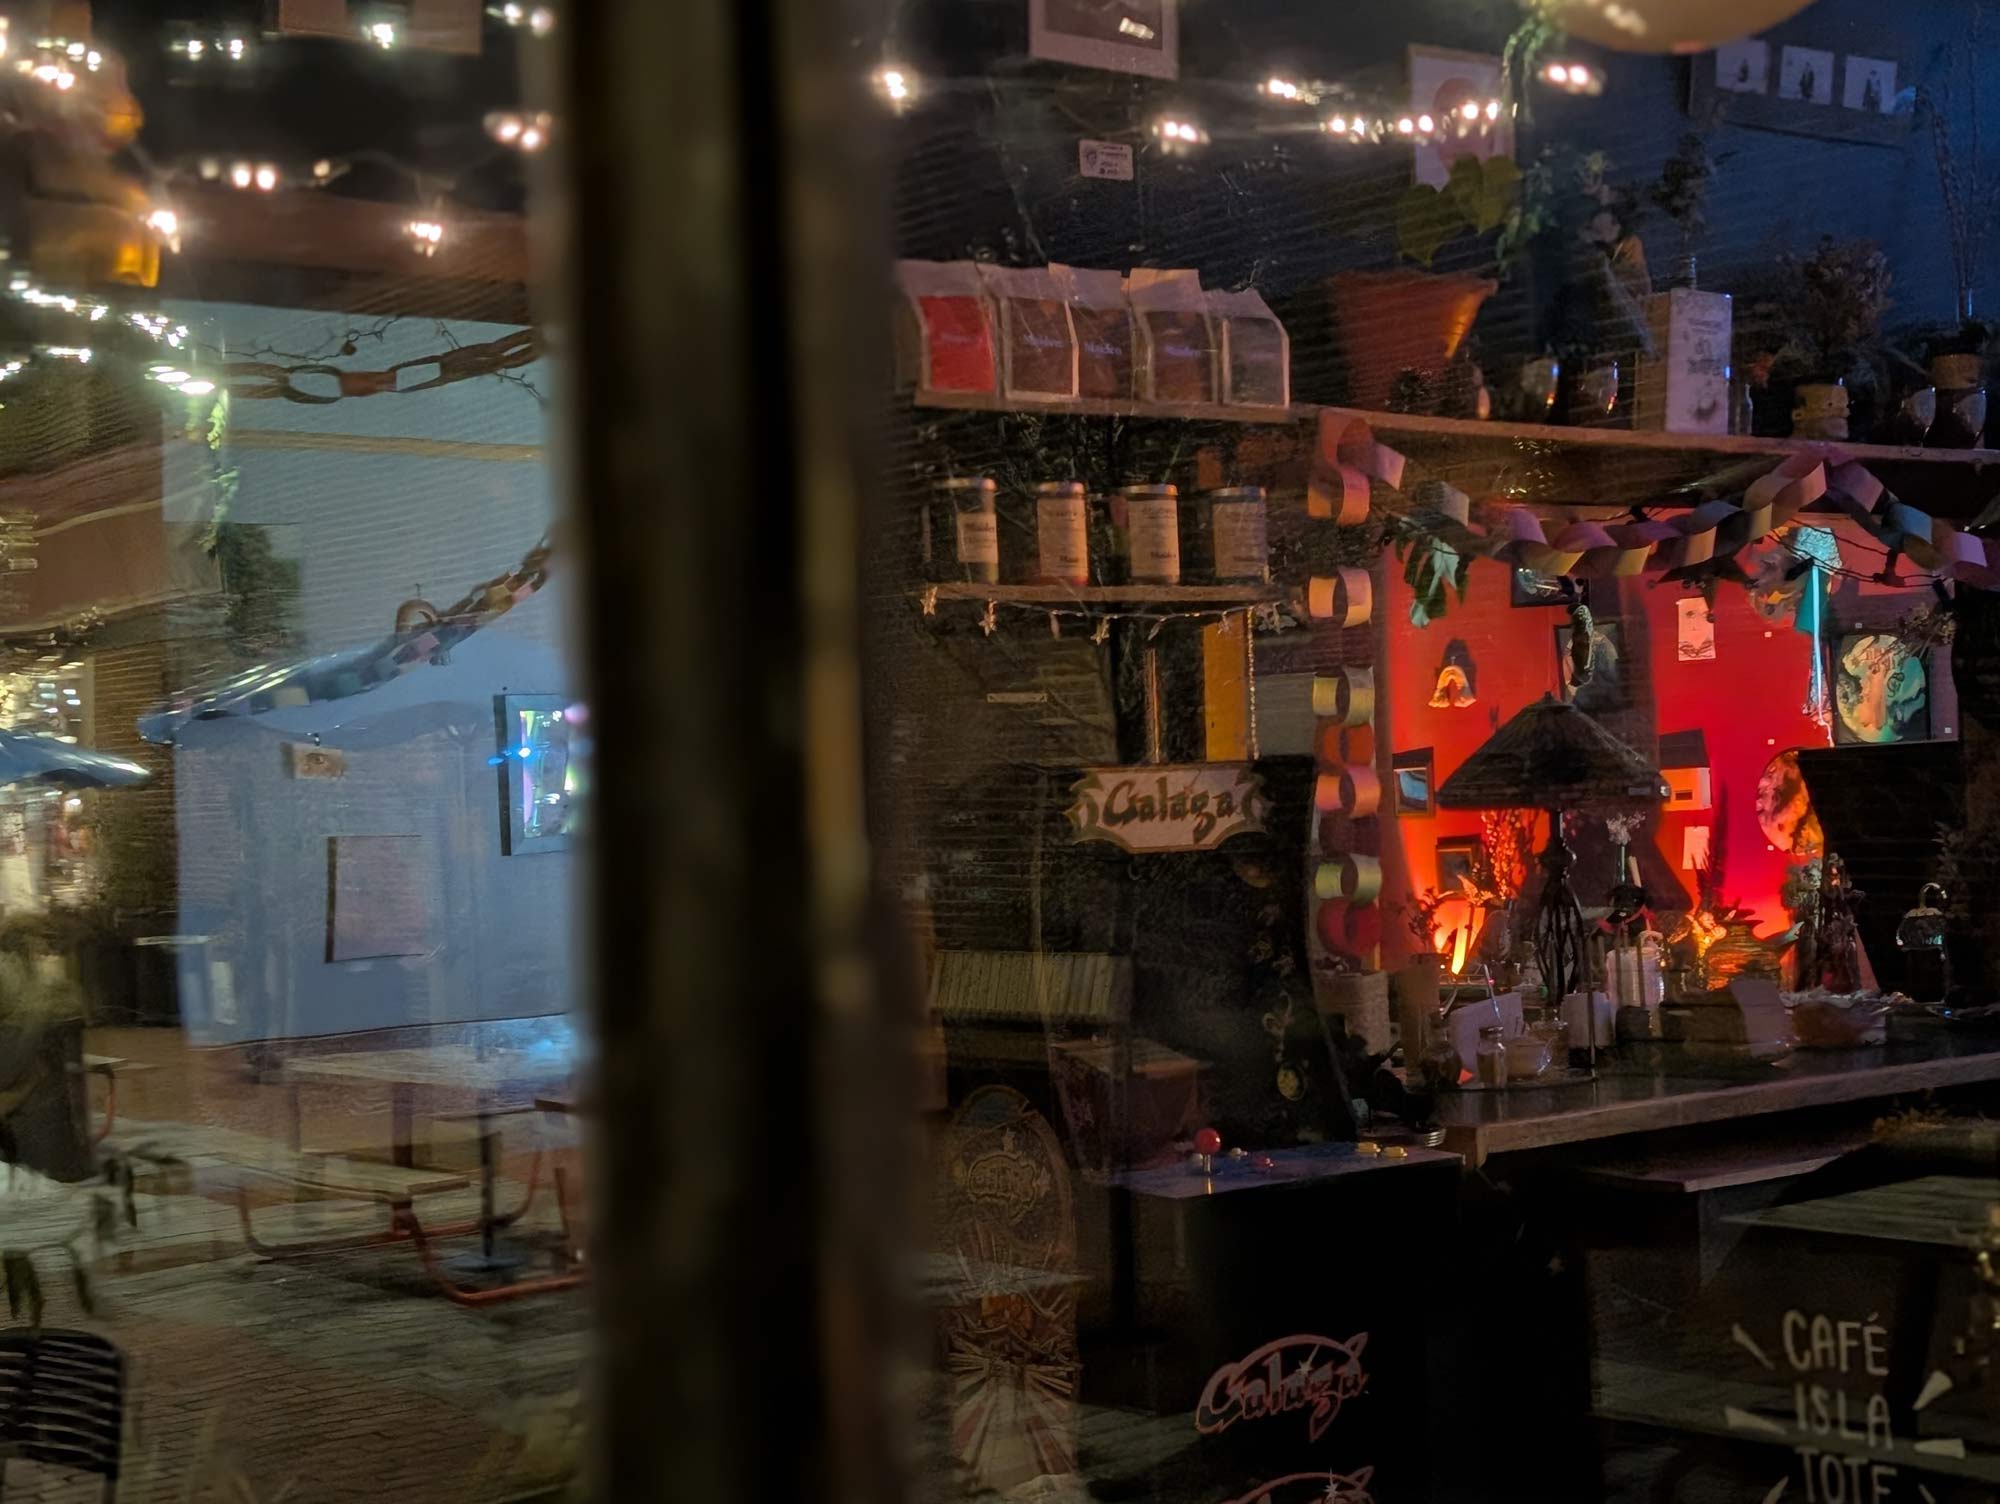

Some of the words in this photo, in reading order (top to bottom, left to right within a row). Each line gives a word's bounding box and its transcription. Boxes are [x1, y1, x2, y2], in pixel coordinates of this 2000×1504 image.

[1102, 776, 1234, 845] Galaga
[1782, 1309, 1890, 1376] CAFÉ
[1794, 1382, 1894, 1450] ISLA
